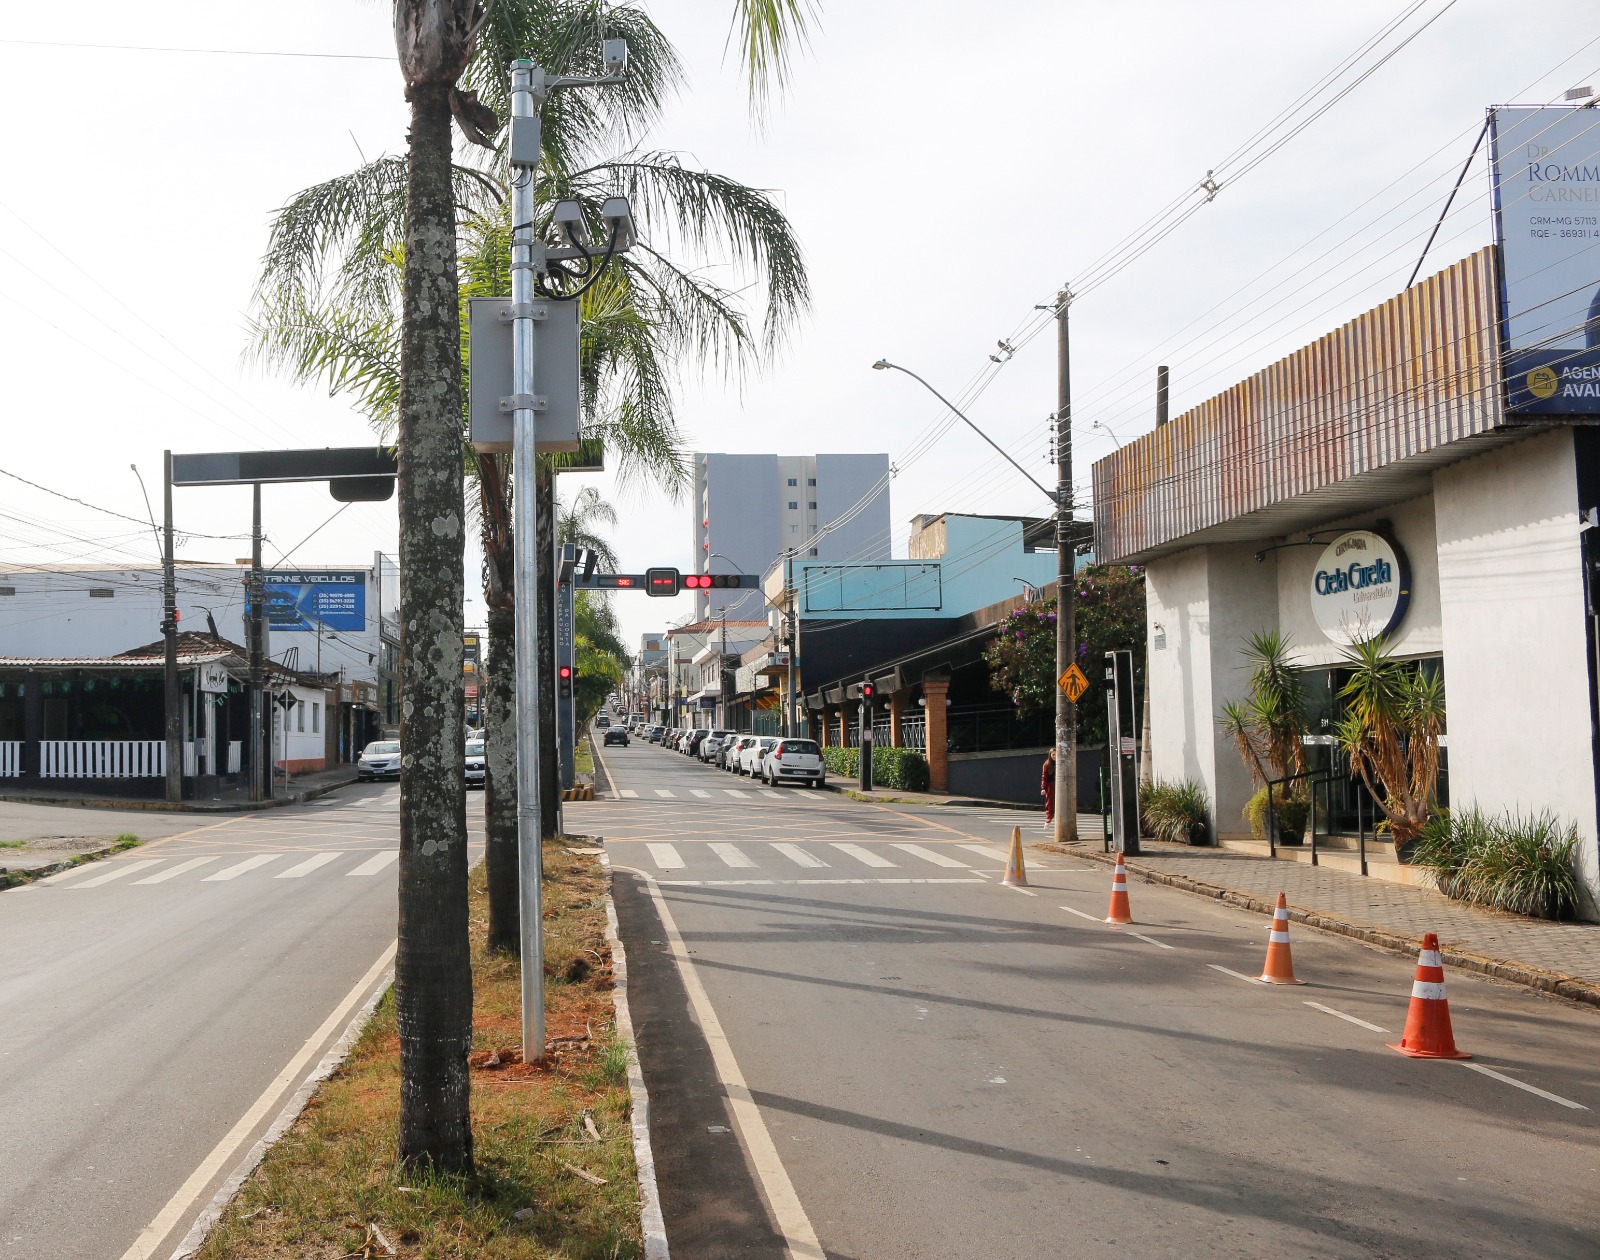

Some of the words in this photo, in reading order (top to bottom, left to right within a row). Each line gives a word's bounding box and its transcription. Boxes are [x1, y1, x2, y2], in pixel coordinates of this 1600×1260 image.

[1529, 216, 1572, 225] CRM-MG
[1574, 216, 1597, 225] 57113
[1530, 229, 1550, 238] RQE
[1560, 229, 1586, 238] 36931
